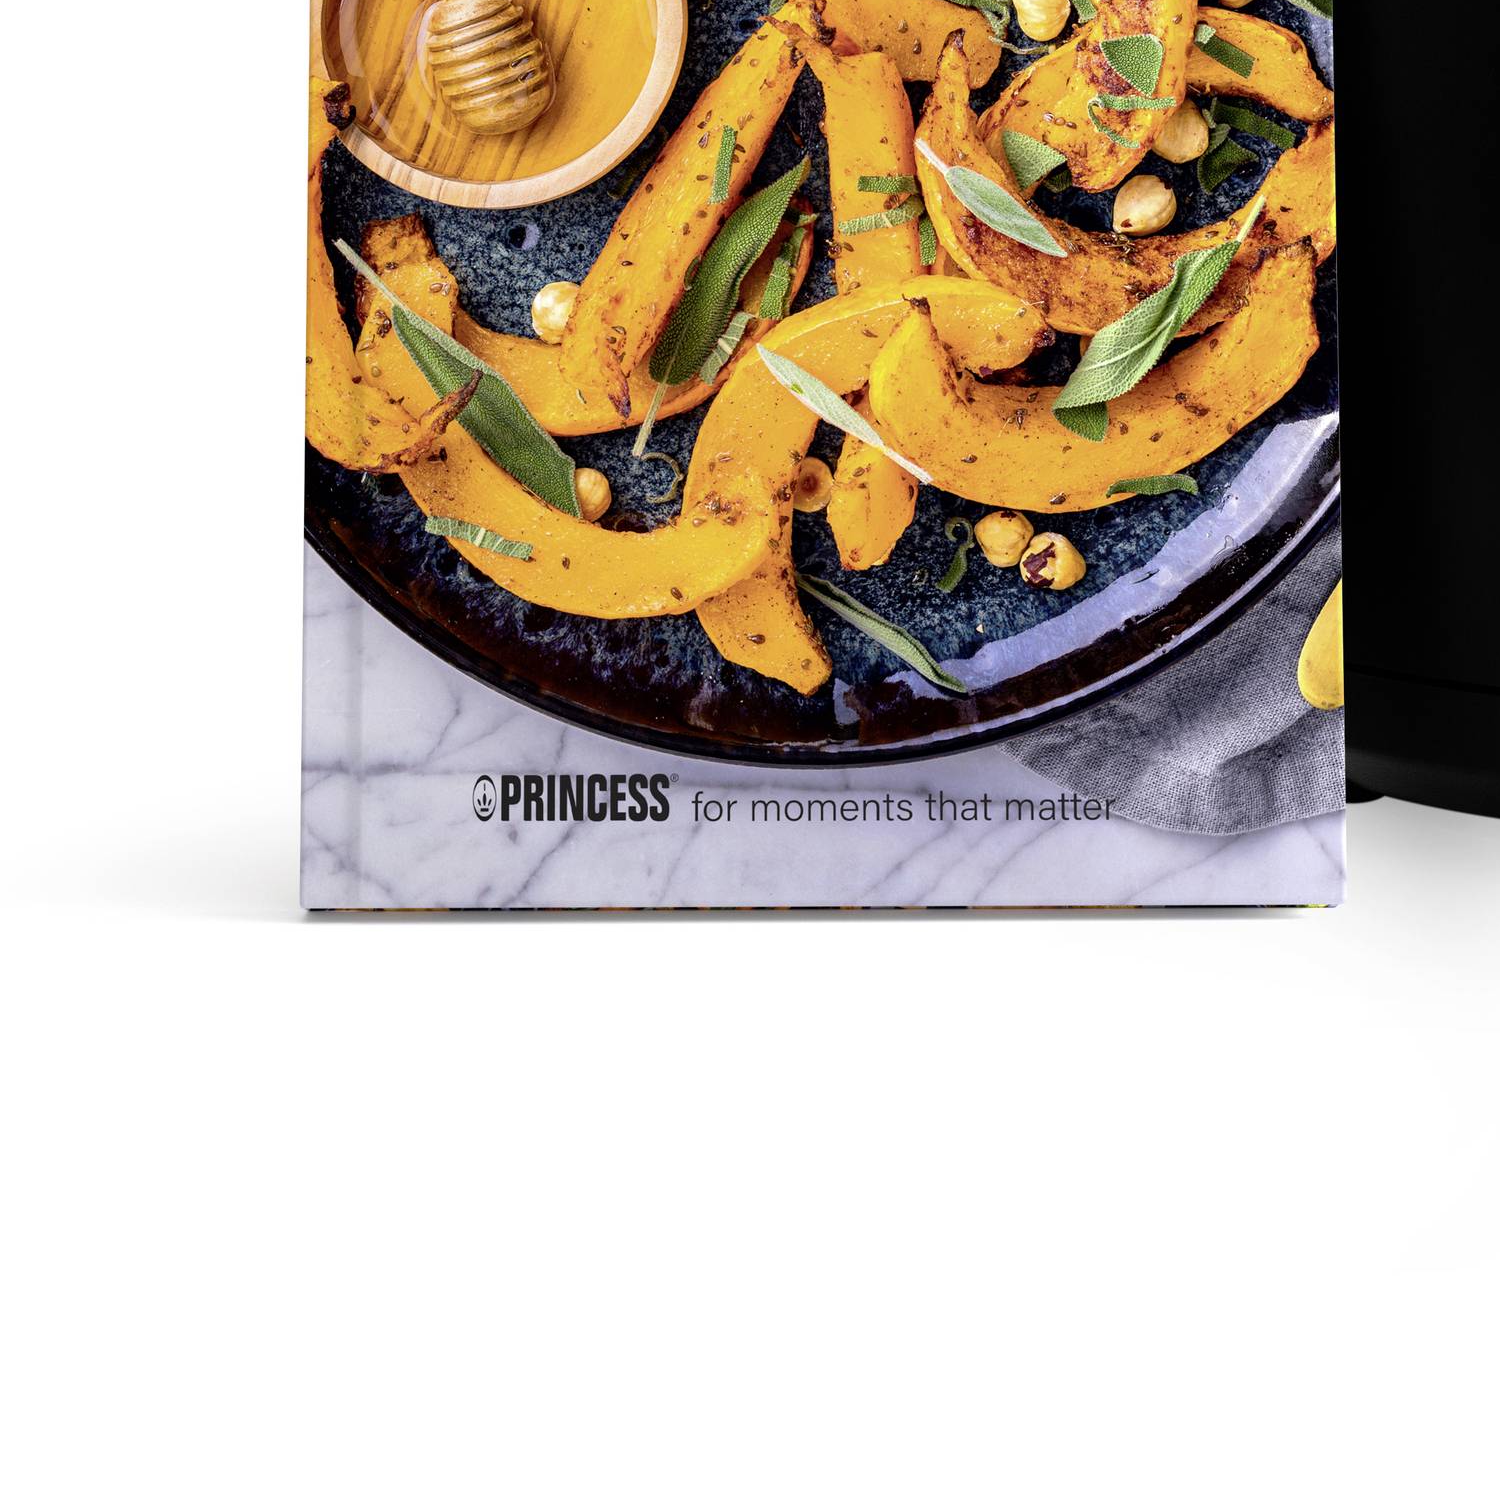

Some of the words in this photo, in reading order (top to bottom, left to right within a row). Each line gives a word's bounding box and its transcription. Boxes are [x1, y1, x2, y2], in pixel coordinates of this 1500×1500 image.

[691, 790, 738, 822] for
[751, 793, 913, 822] moments
[924, 790, 993, 821] that
[1005, 793, 1117, 821] matter
